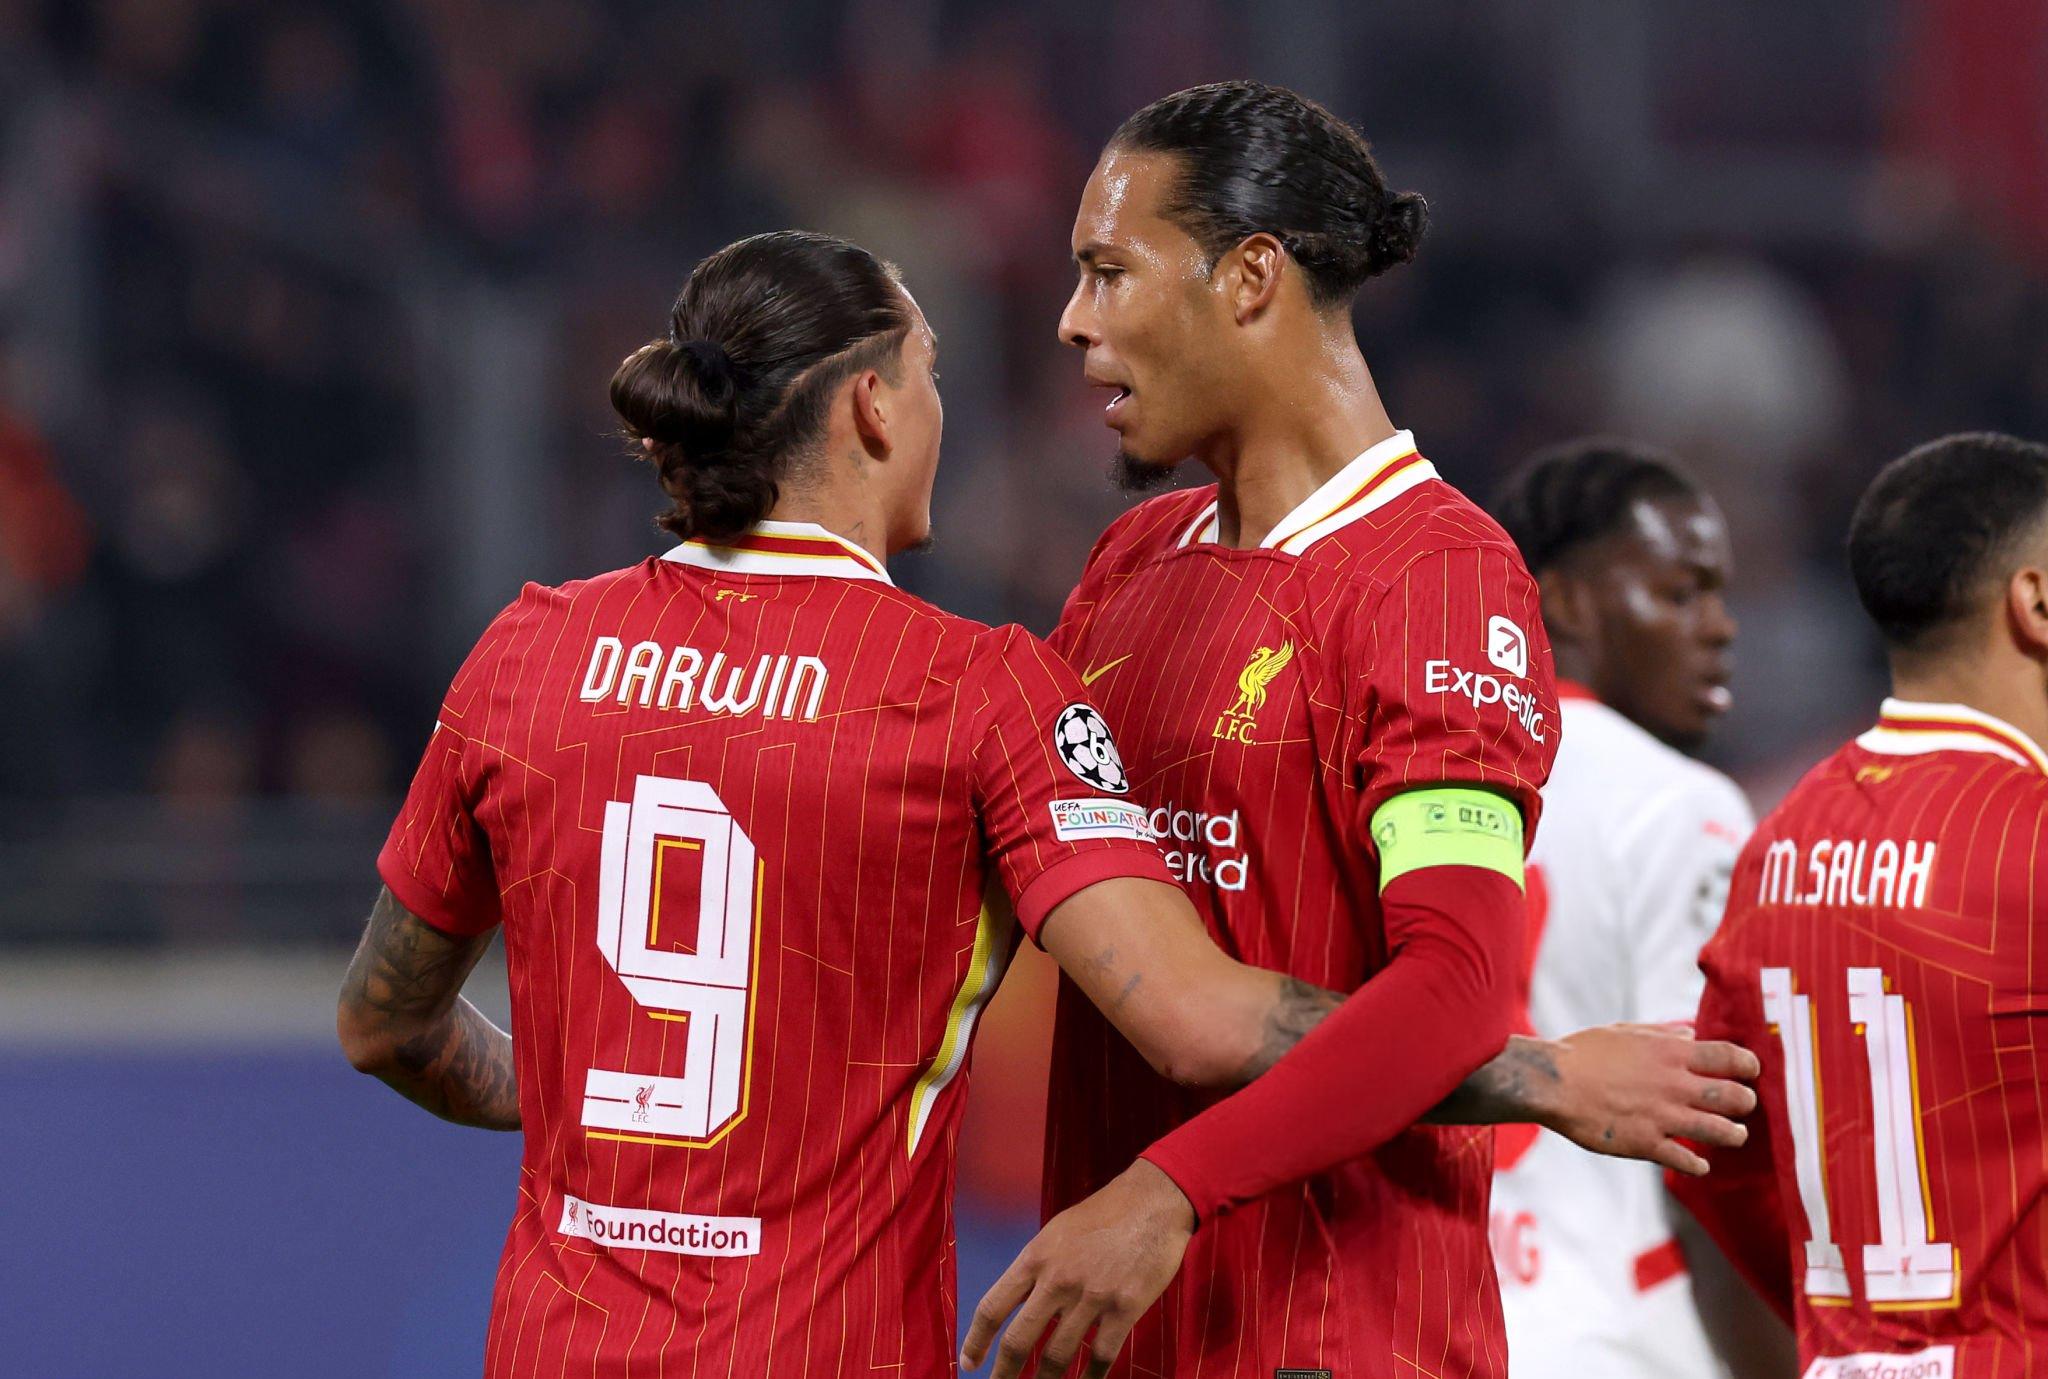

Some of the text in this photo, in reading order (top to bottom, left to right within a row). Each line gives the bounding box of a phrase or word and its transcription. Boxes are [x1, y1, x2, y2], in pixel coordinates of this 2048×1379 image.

[579, 636, 829, 722] DARWIN
[1211, 716, 1257, 746] L.F.C.
[1054, 802, 1081, 812] UEFA
[1056, 811, 1150, 829] FOUNDATIO
[1144, 800, 1239, 848] dard
[1157, 848, 1249, 891] ered
[1758, 838, 1936, 909] M.SALAH
[580, 773, 764, 1149] 9
[1760, 966, 1961, 1312] 11
[585, 1208, 749, 1249] Foundation
